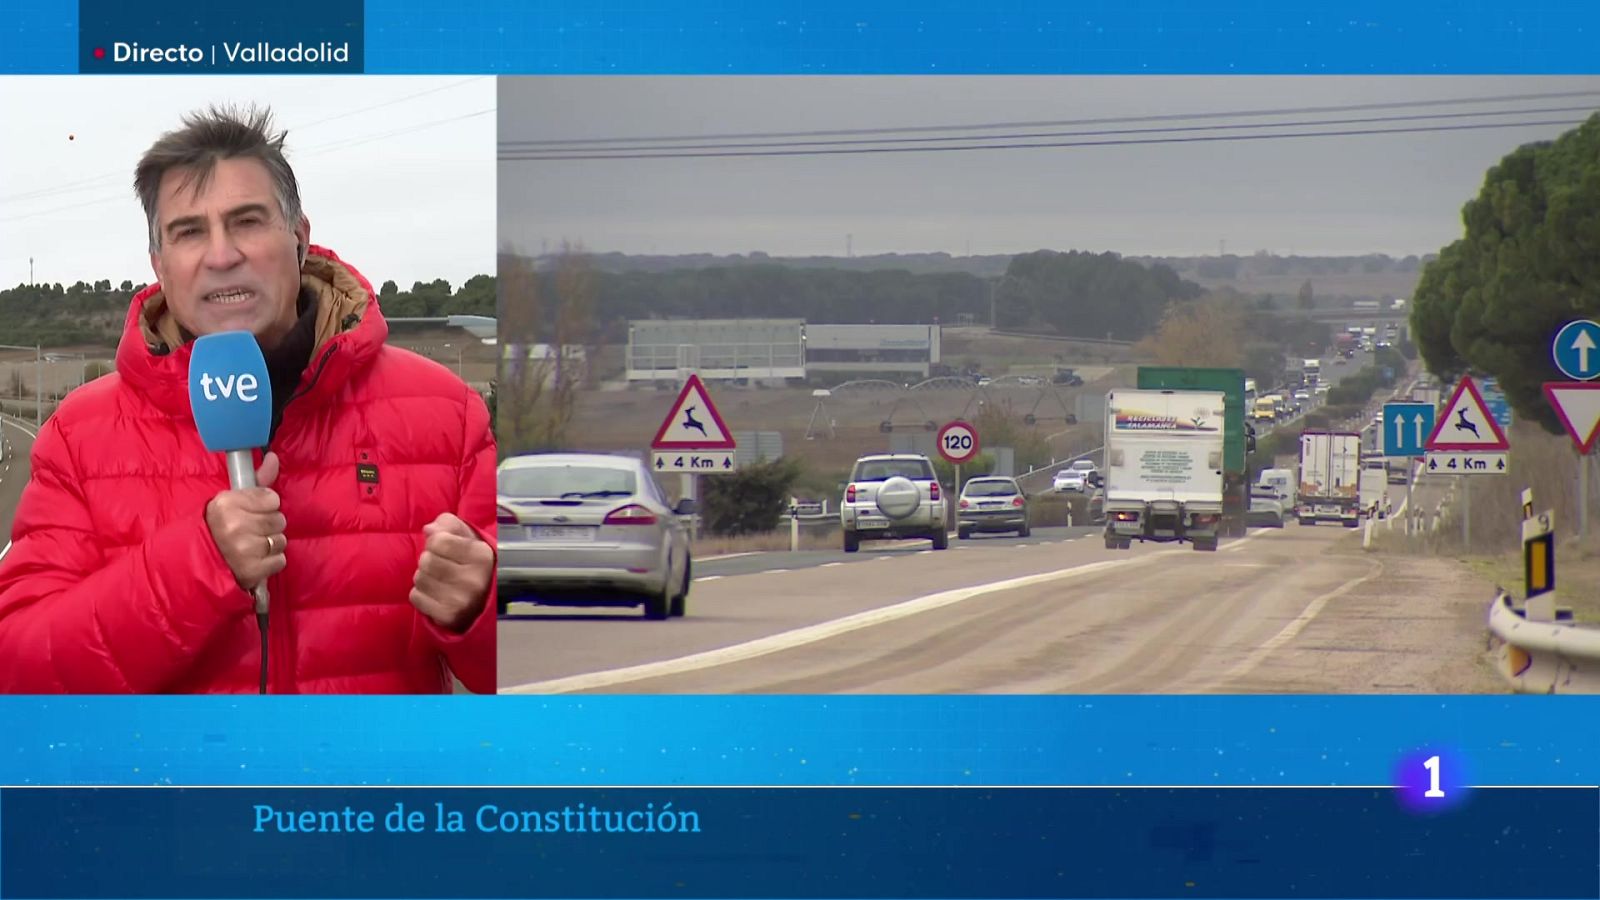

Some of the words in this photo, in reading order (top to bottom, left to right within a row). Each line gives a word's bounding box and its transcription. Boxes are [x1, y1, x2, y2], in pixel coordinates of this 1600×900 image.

[200, 373, 258, 402] tve
[943, 434, 973, 450] 120
[673, 456, 684, 468] 4
[690, 456, 714, 468] Km
[1446, 457, 1457, 469] 4
[1463, 457, 1487, 469] Km
[1537, 513, 1550, 532] 9
